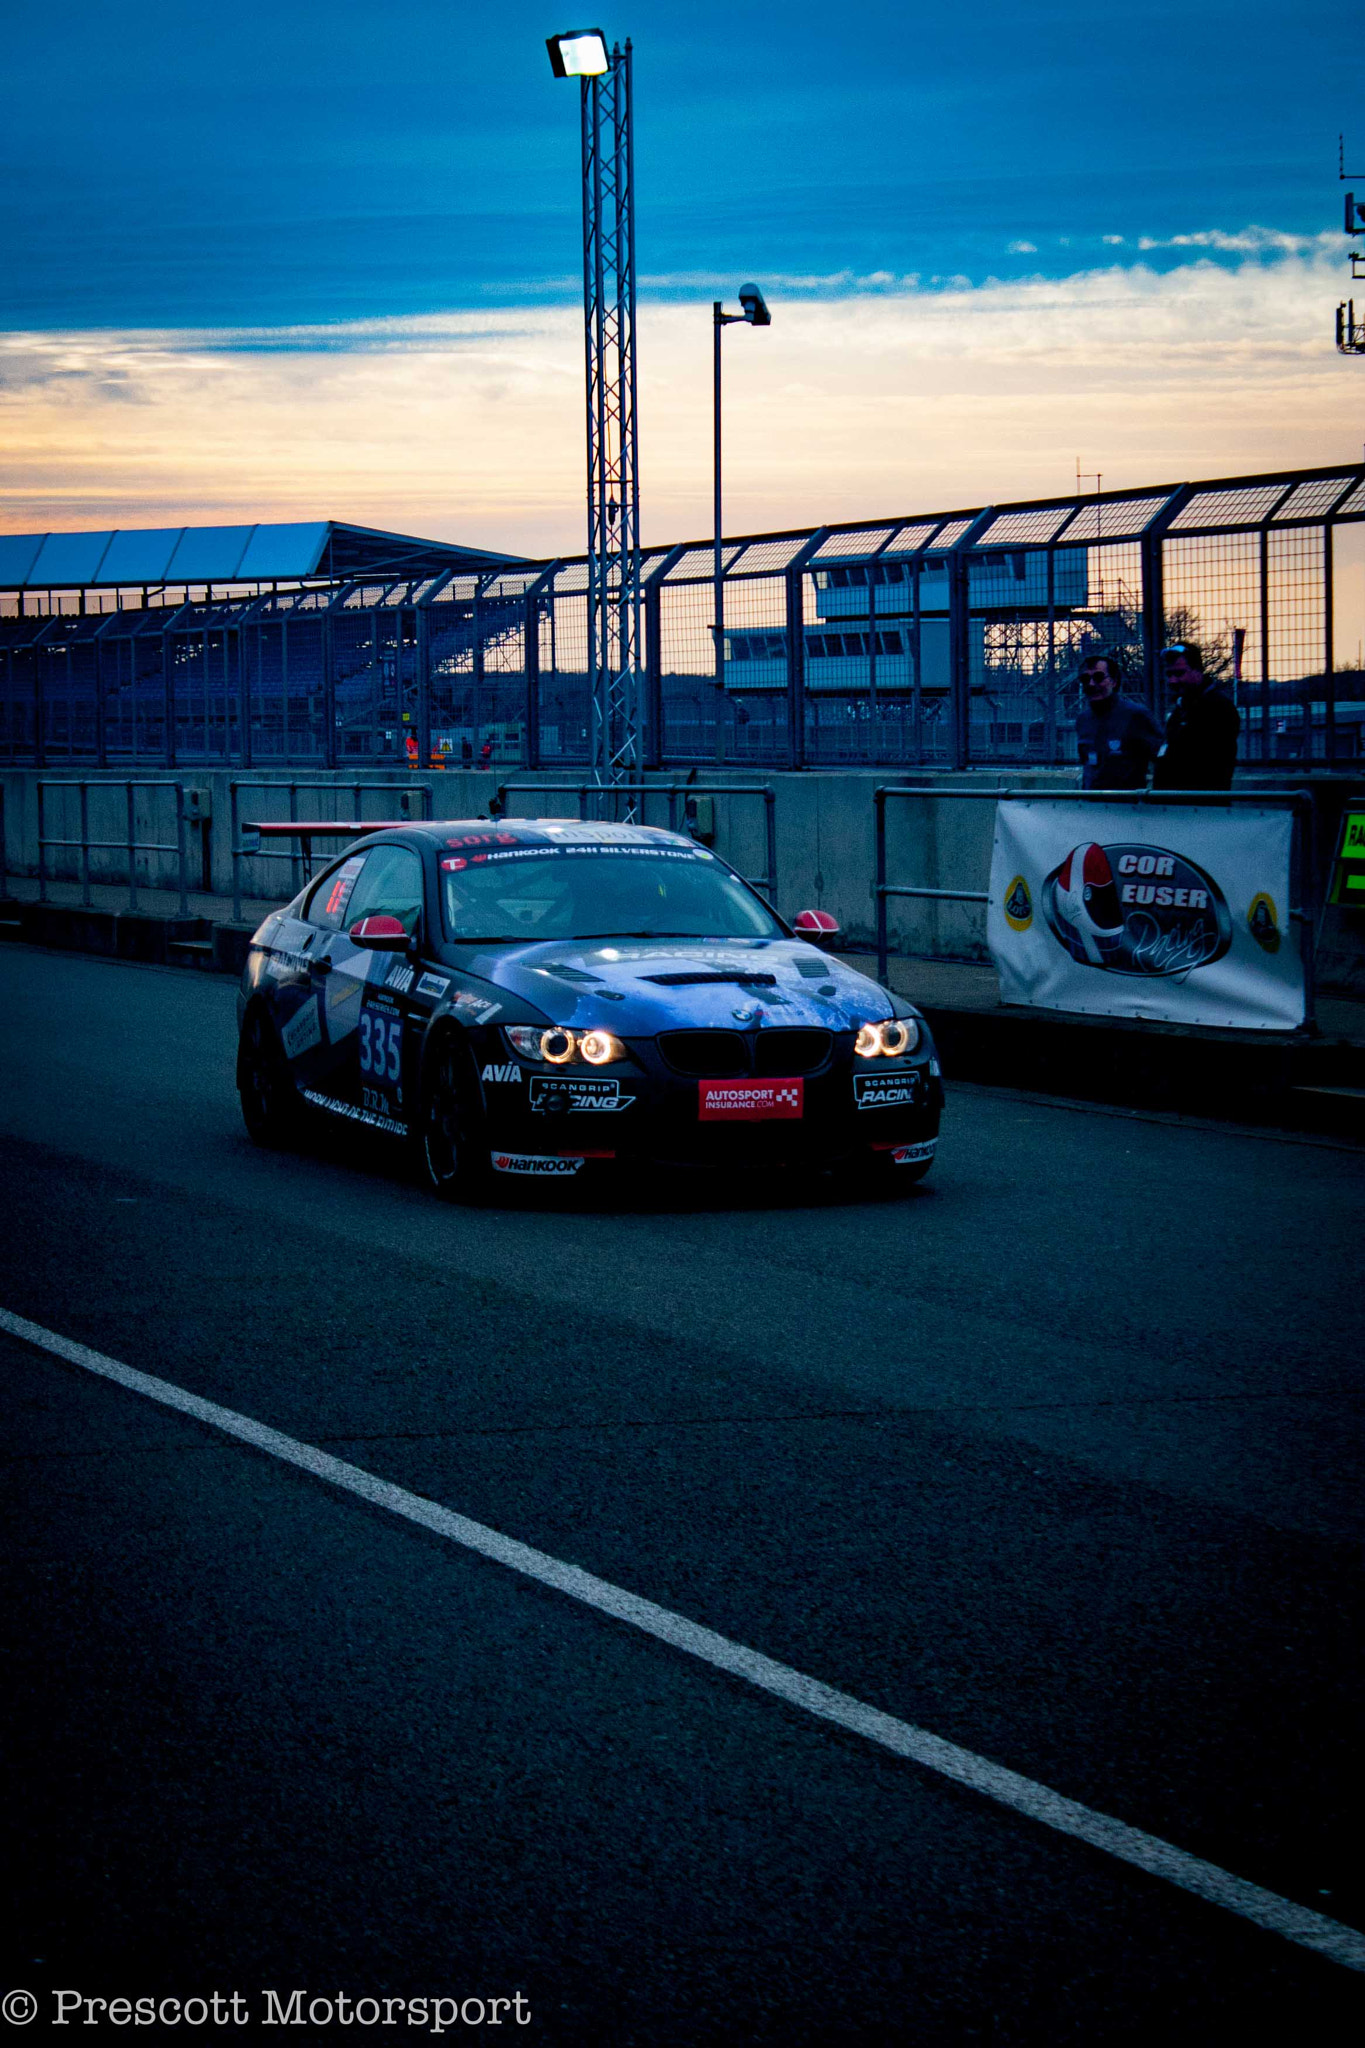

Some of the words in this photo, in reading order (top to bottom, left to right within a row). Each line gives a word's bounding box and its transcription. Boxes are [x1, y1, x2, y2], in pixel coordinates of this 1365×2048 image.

[446, 831, 518, 848] sorg
[1349, 825, 1365, 847] RA
[565, 846, 598, 855] 24H
[599, 846, 695, 860] SILVERSTONE
[1118, 854, 1176, 878] COR
[1121, 884, 1209, 910] EUSER
[384, 964, 415, 993] AVIA
[360, 1013, 401, 1081] 335
[481, 1060, 523, 1083] AVIA
[541, 1082, 611, 1093] SCANGRIP
[865, 1077, 916, 1087] SCANGRIP
[705, 1089, 775, 1101] AUTOSPORT
[861, 1088, 913, 1103] RACIN
[705, 1100, 775, 1109] INSURANCE.COM
